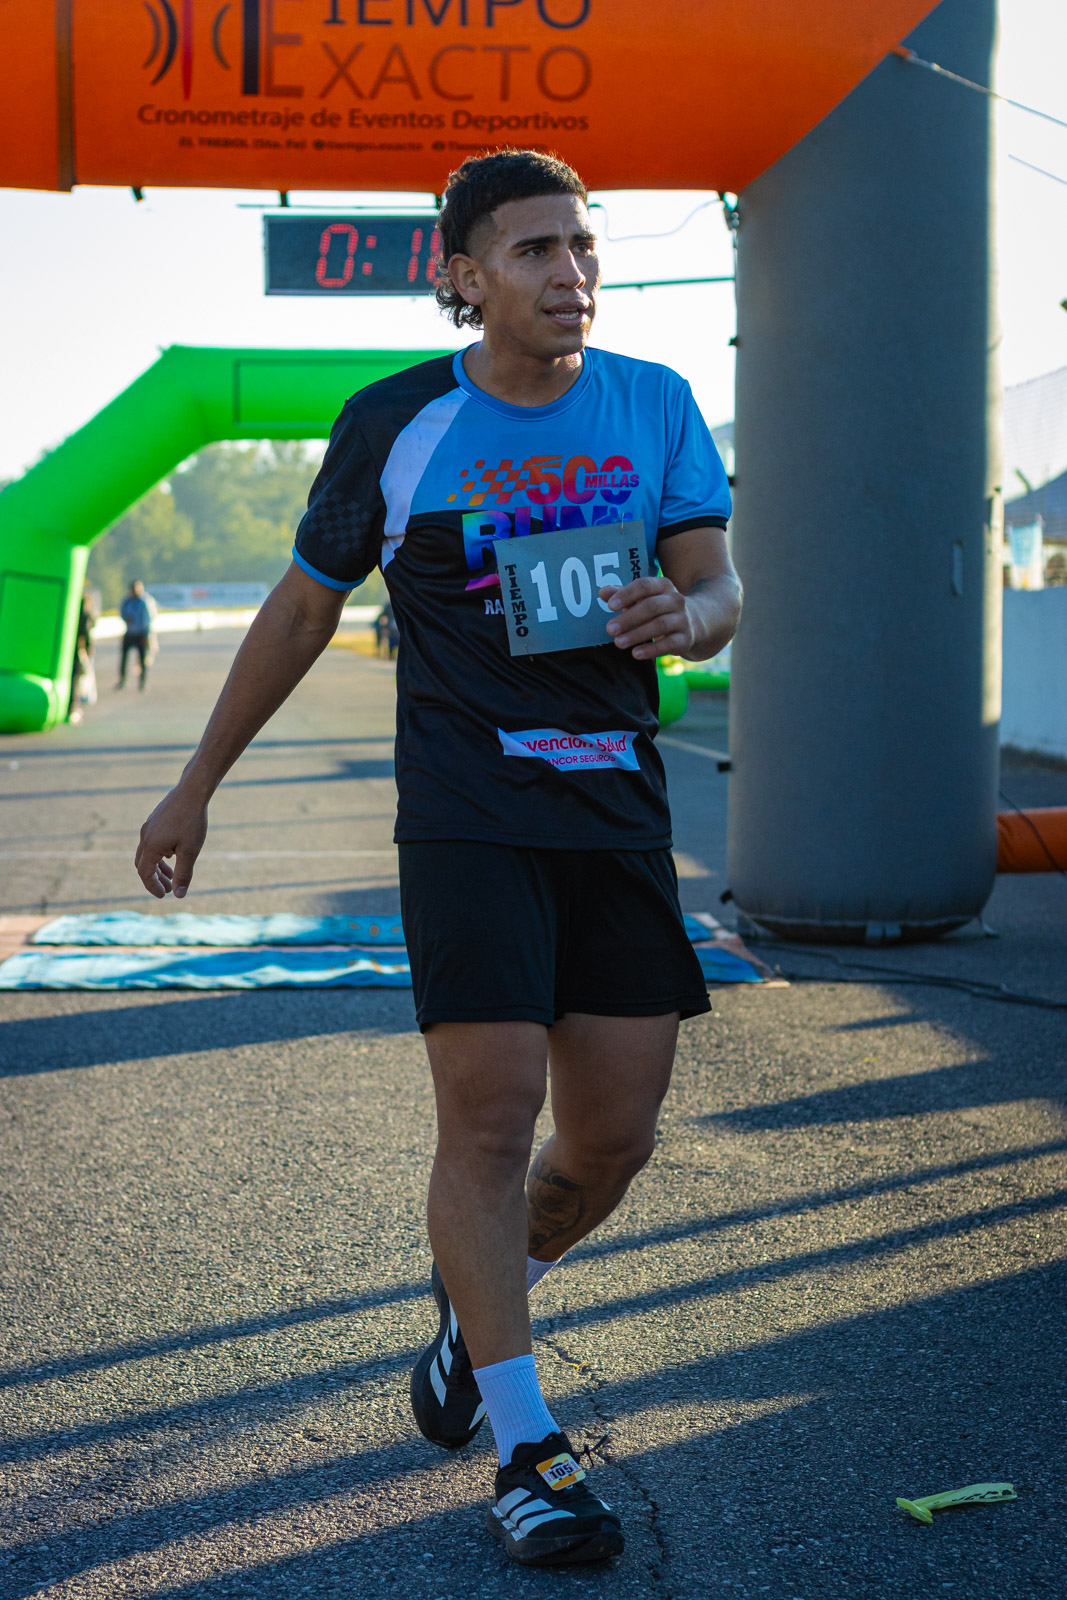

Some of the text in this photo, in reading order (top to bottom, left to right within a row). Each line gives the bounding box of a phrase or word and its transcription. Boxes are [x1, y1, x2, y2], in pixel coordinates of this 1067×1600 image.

[138, 103, 589, 133] Cronometraje de Eventos Deportivos
[526, 455, 634, 505] 500
[585, 474, 640, 488] MILLAS
[504, 563, 529, 638] TIEMPO
[529, 551, 624, 623] 105
[548, 1462, 574, 1479] 105
